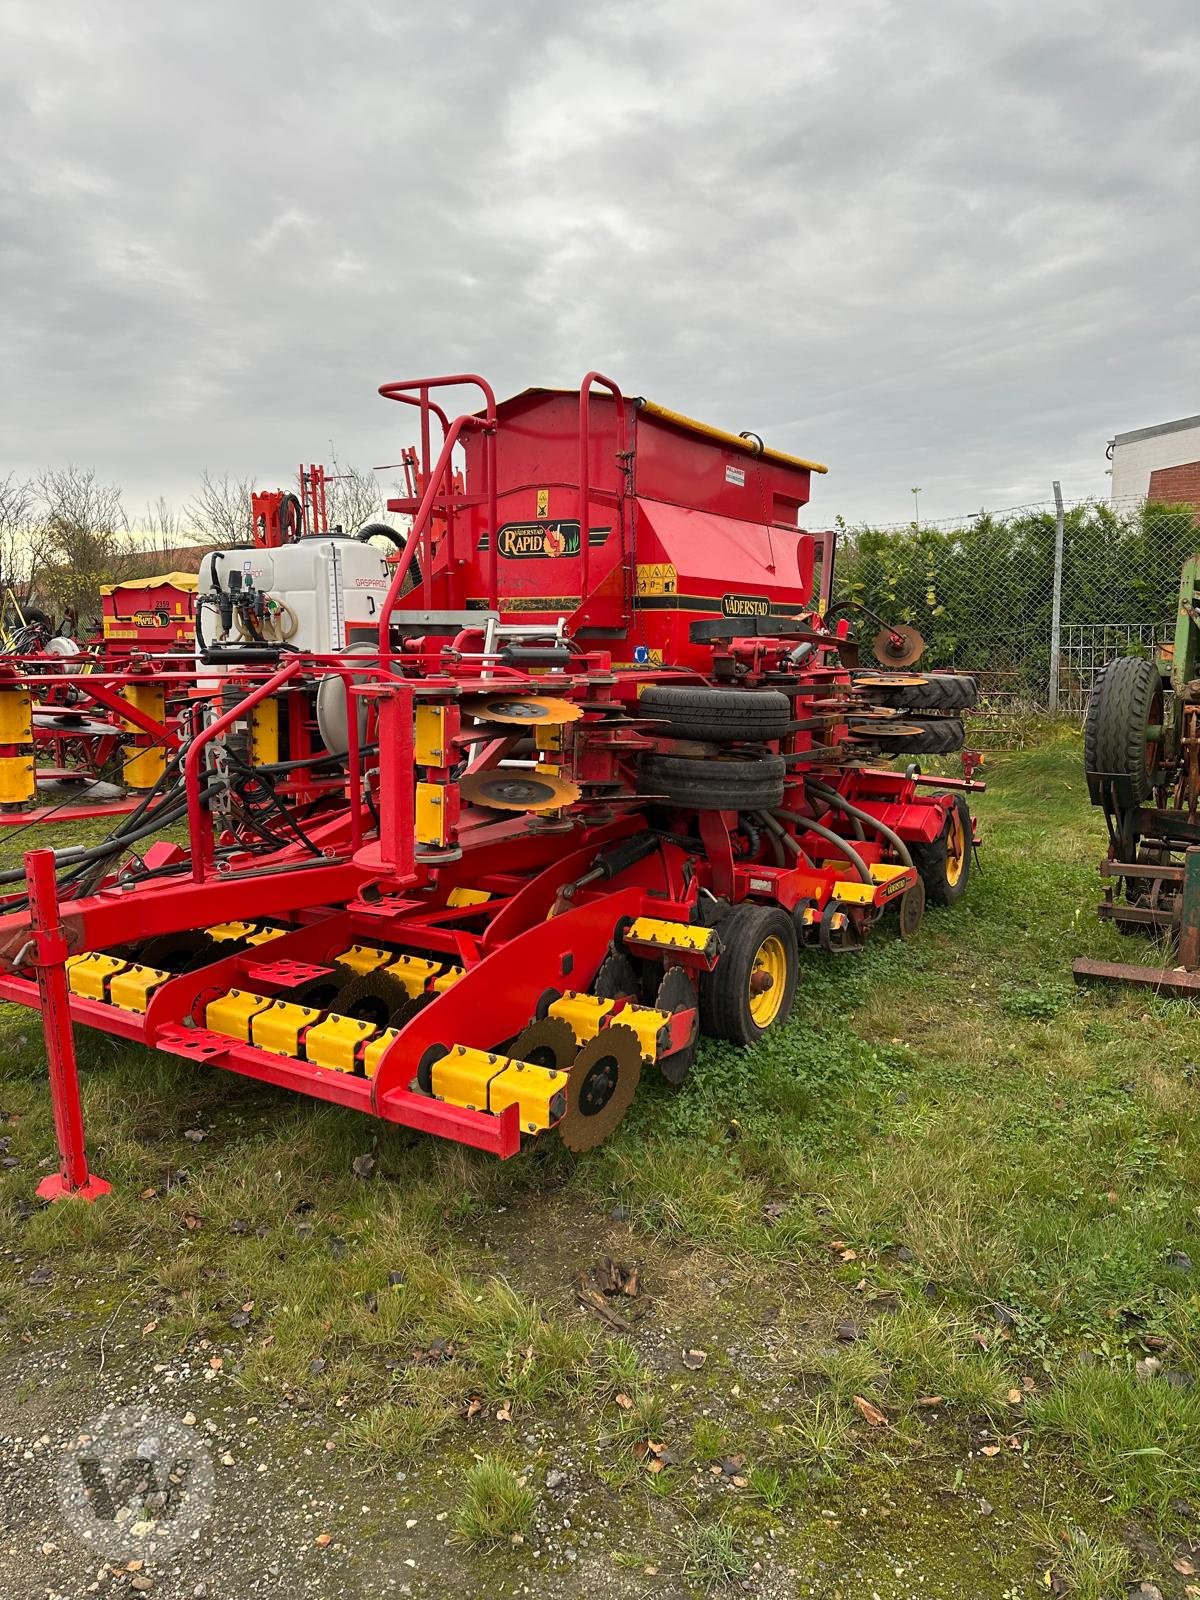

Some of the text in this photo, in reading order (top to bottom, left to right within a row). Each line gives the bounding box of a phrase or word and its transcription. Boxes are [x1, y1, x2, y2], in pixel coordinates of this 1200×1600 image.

[504, 530, 543, 555] RAPID
[355, 578, 387, 588] GASPARDO
[725, 596, 768, 616] VÄDERSTAD
